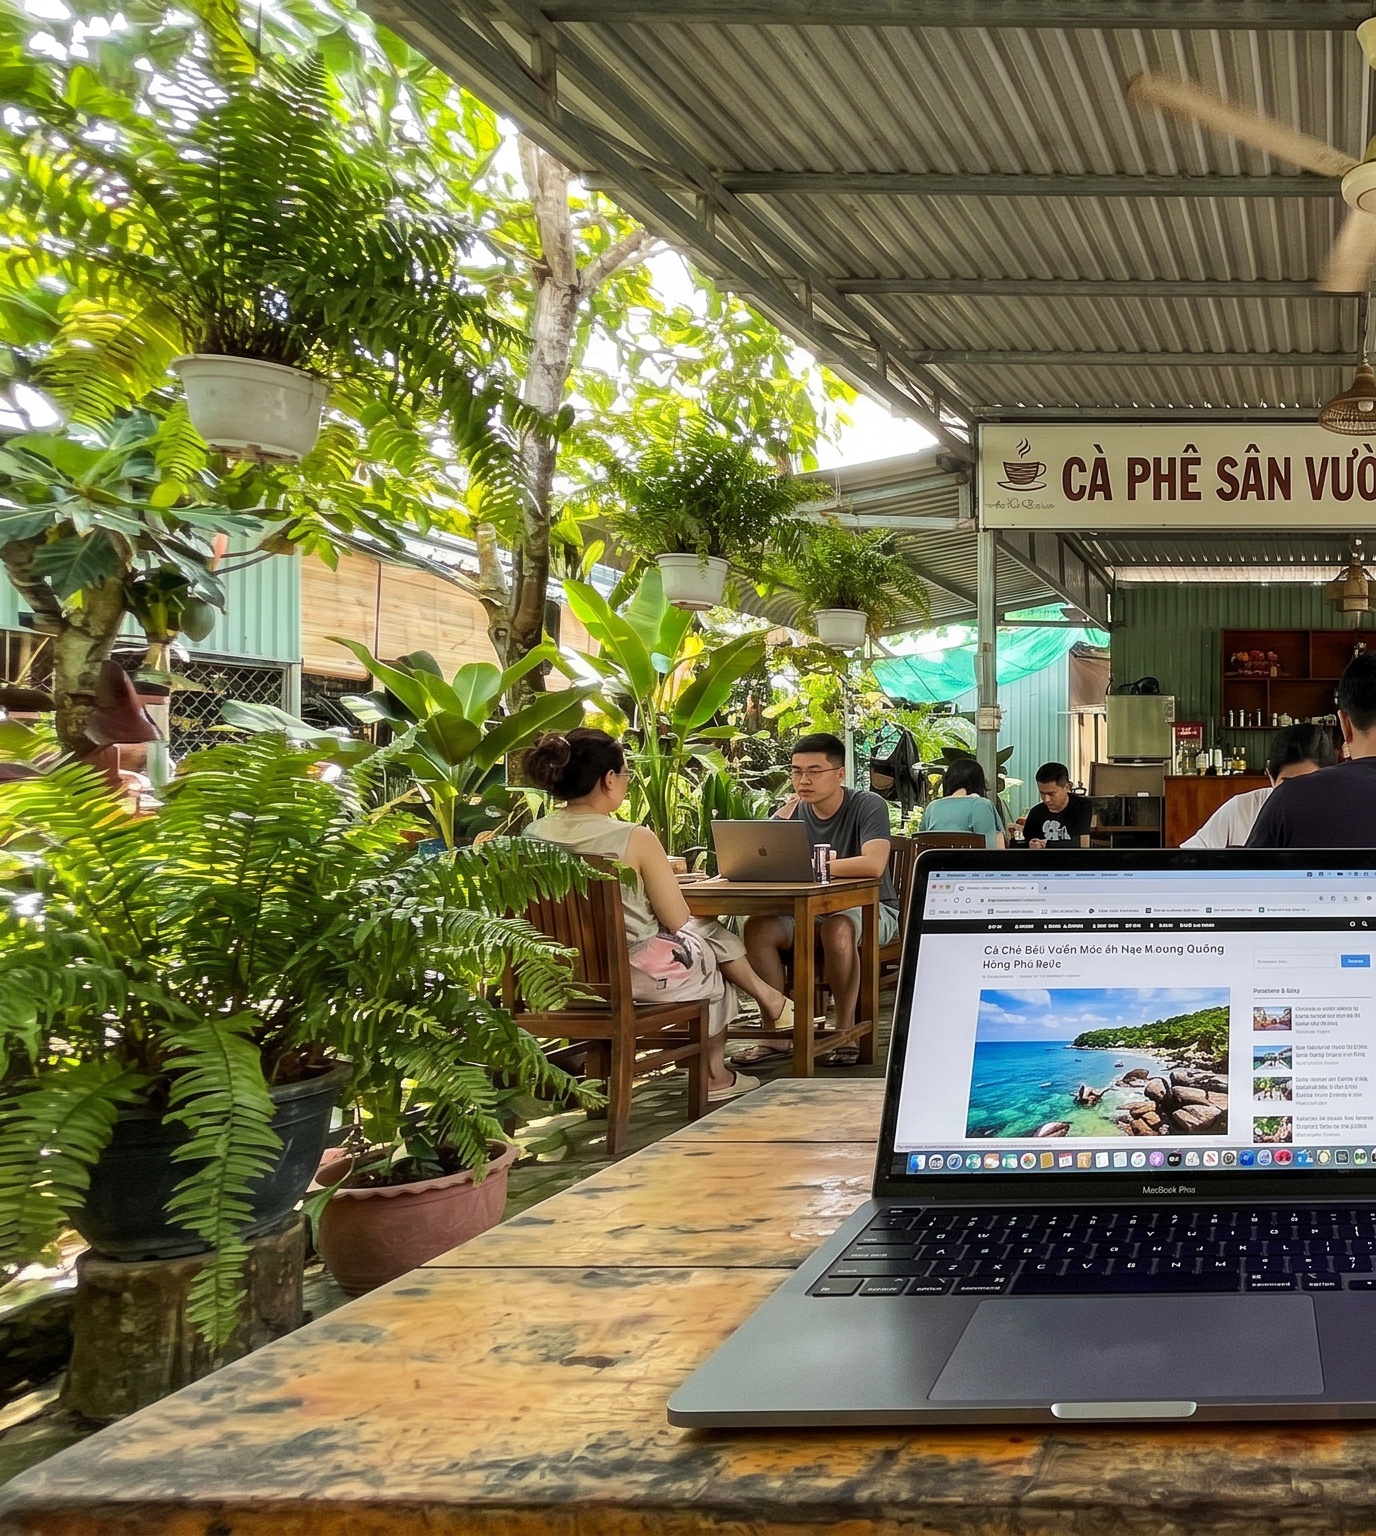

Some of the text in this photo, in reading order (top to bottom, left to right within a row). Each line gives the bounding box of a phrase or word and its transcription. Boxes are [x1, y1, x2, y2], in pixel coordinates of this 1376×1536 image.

[1063, 444, 1112, 502] CÀ
[1127, 444, 1202, 502] PHÊ
[1216, 443, 1293, 502] SÂN
